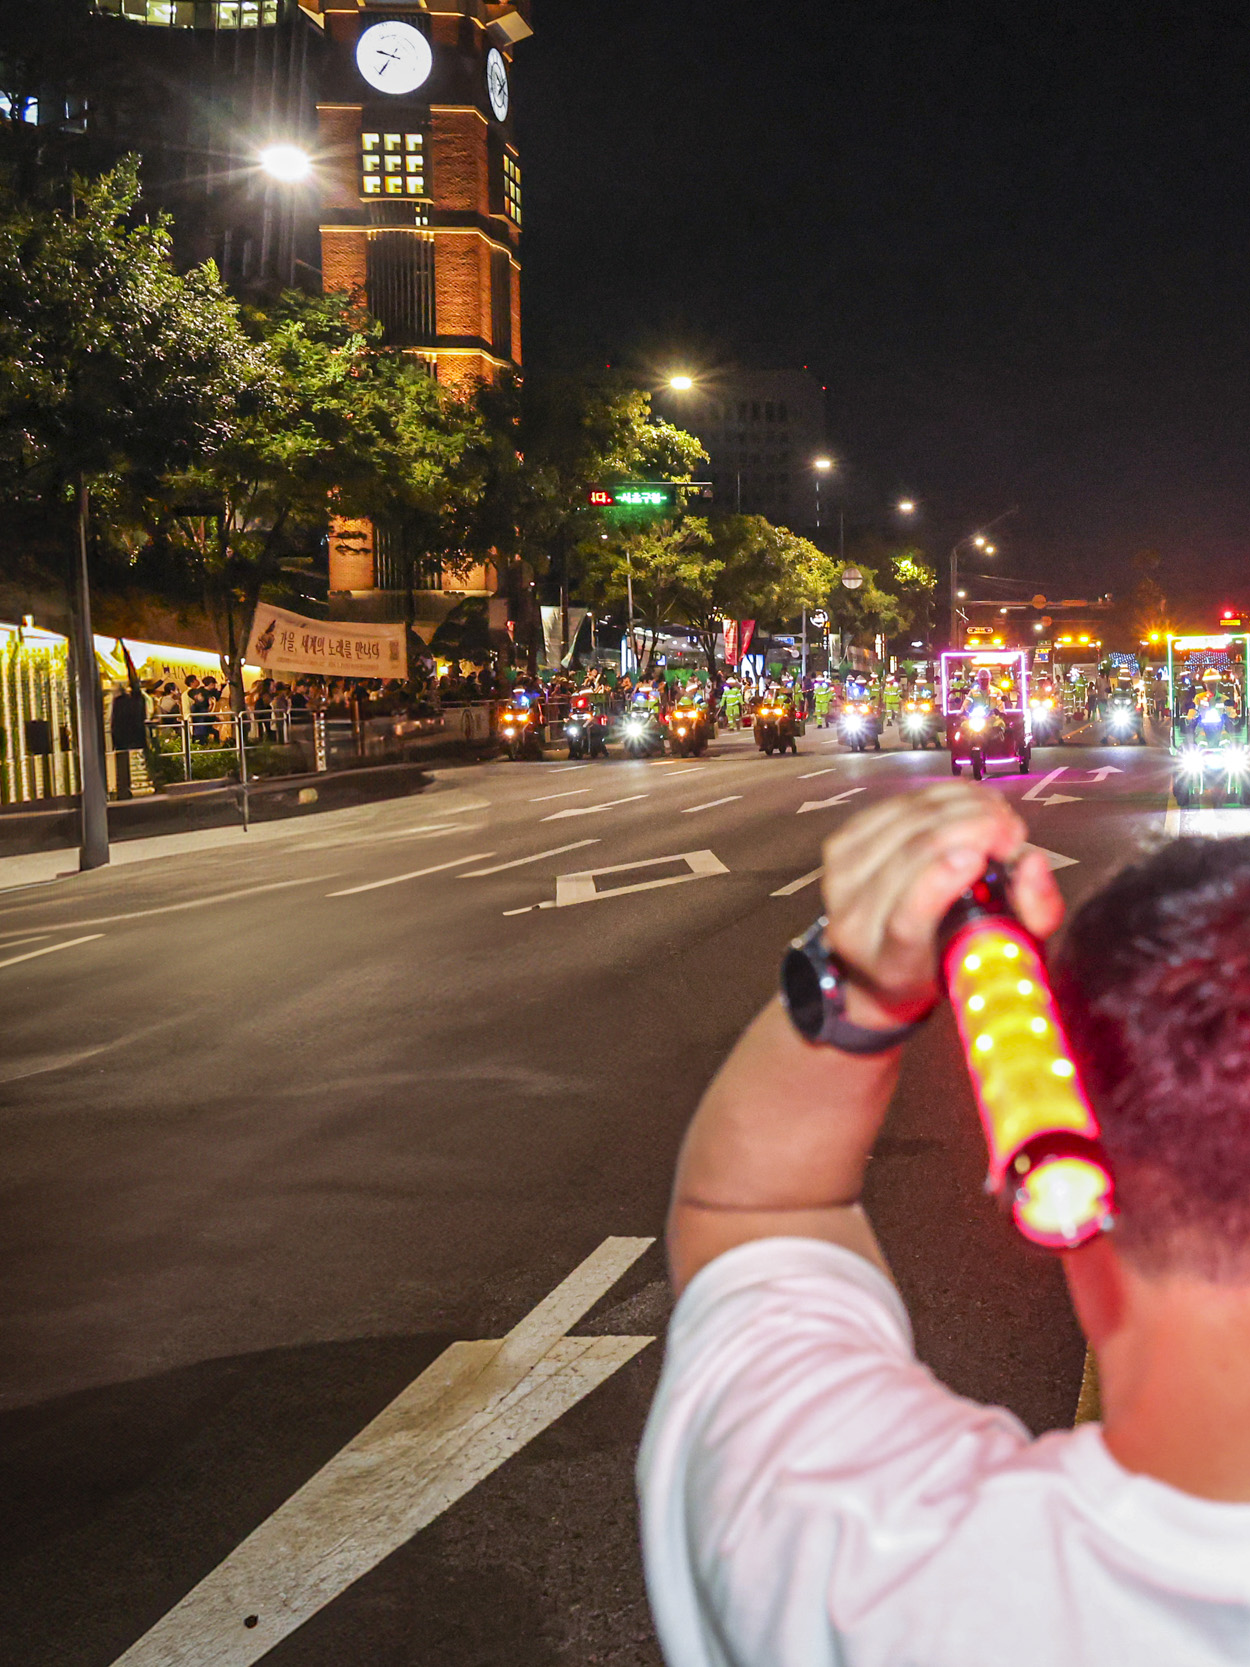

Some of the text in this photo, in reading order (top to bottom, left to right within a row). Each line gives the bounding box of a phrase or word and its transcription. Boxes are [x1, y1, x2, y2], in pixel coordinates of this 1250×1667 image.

[280, 631, 297, 653] 가을,
[301, 634, 326, 657] 세계의
[328, 638, 352, 659] 노래를
[354, 640, 380, 660] 만나다
